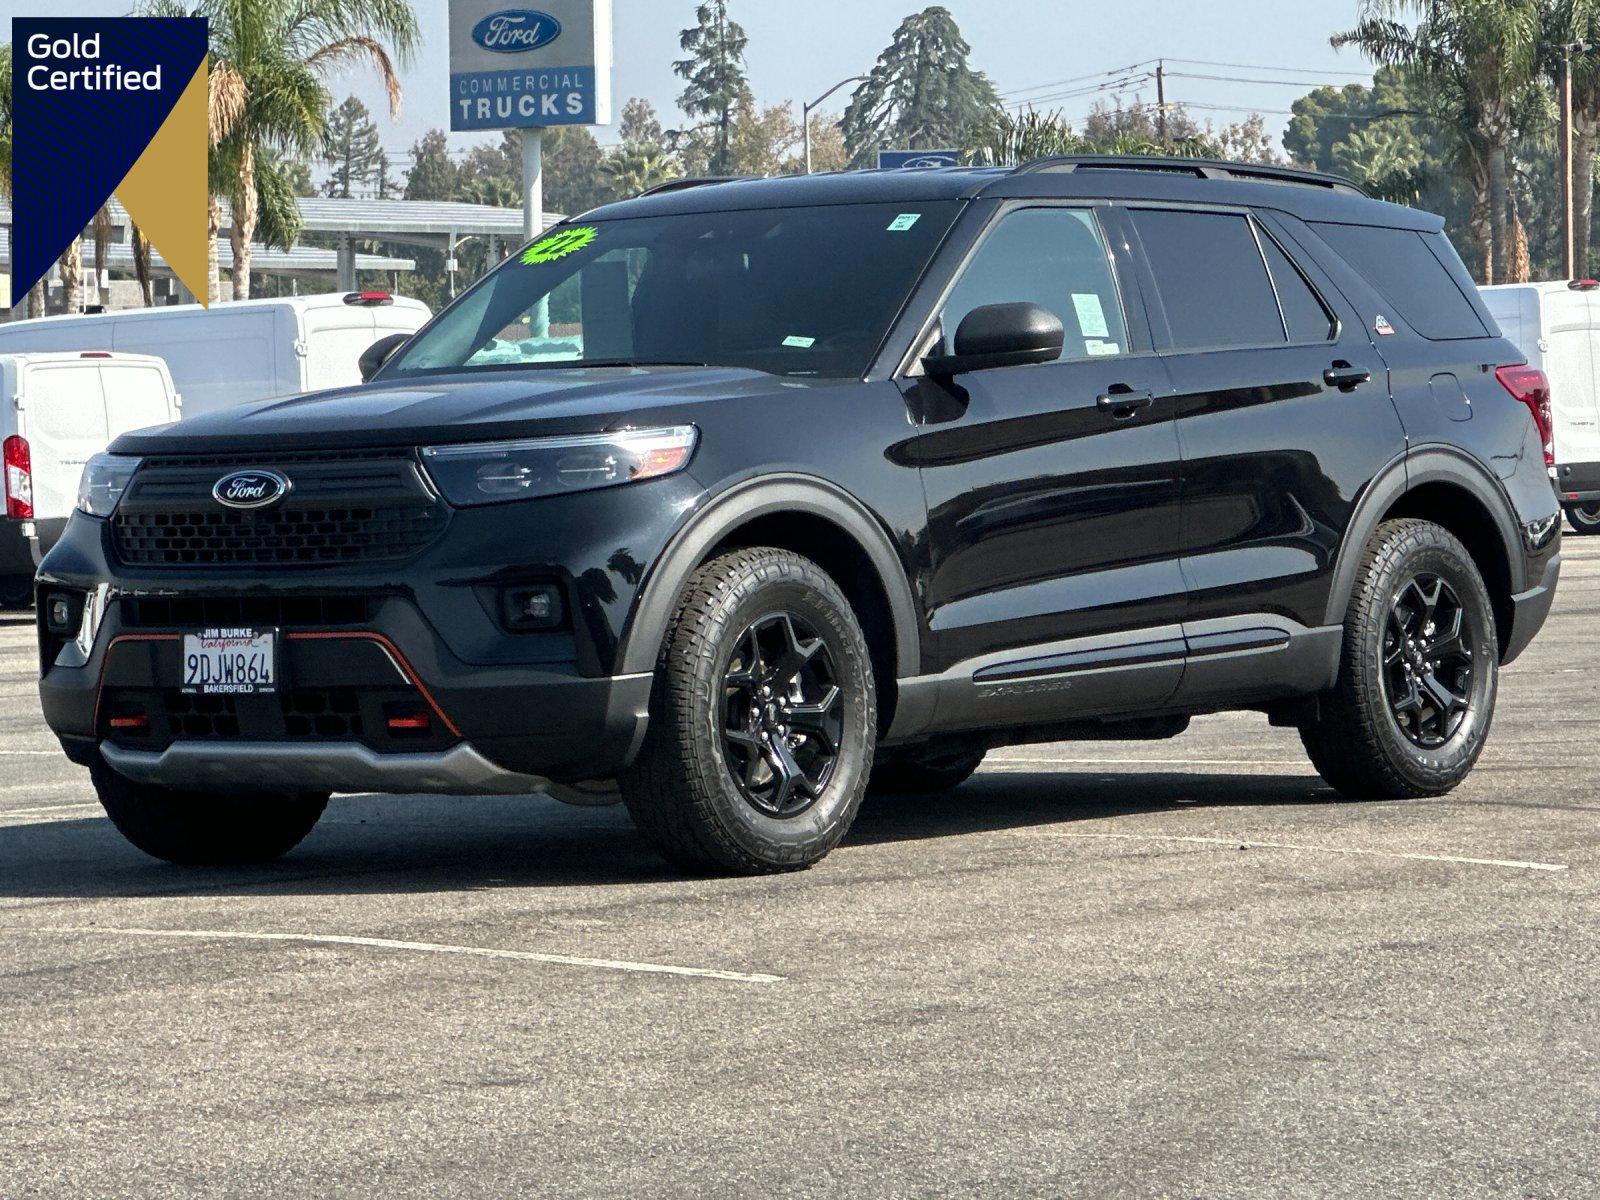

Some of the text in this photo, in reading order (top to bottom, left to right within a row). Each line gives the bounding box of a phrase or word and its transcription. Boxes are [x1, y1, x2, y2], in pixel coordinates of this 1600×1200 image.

[484, 16, 541, 46] Ford
[459, 73, 583, 95] COMMERCIAL
[459, 92, 583, 120] TRUCKS
[227, 477, 267, 499] Ford
[203, 628, 252, 638] JIM BURKE
[201, 639, 259, 652] California
[187, 653, 270, 684] 9DJW864
[203, 684, 253, 693] BAKERSFIELD
